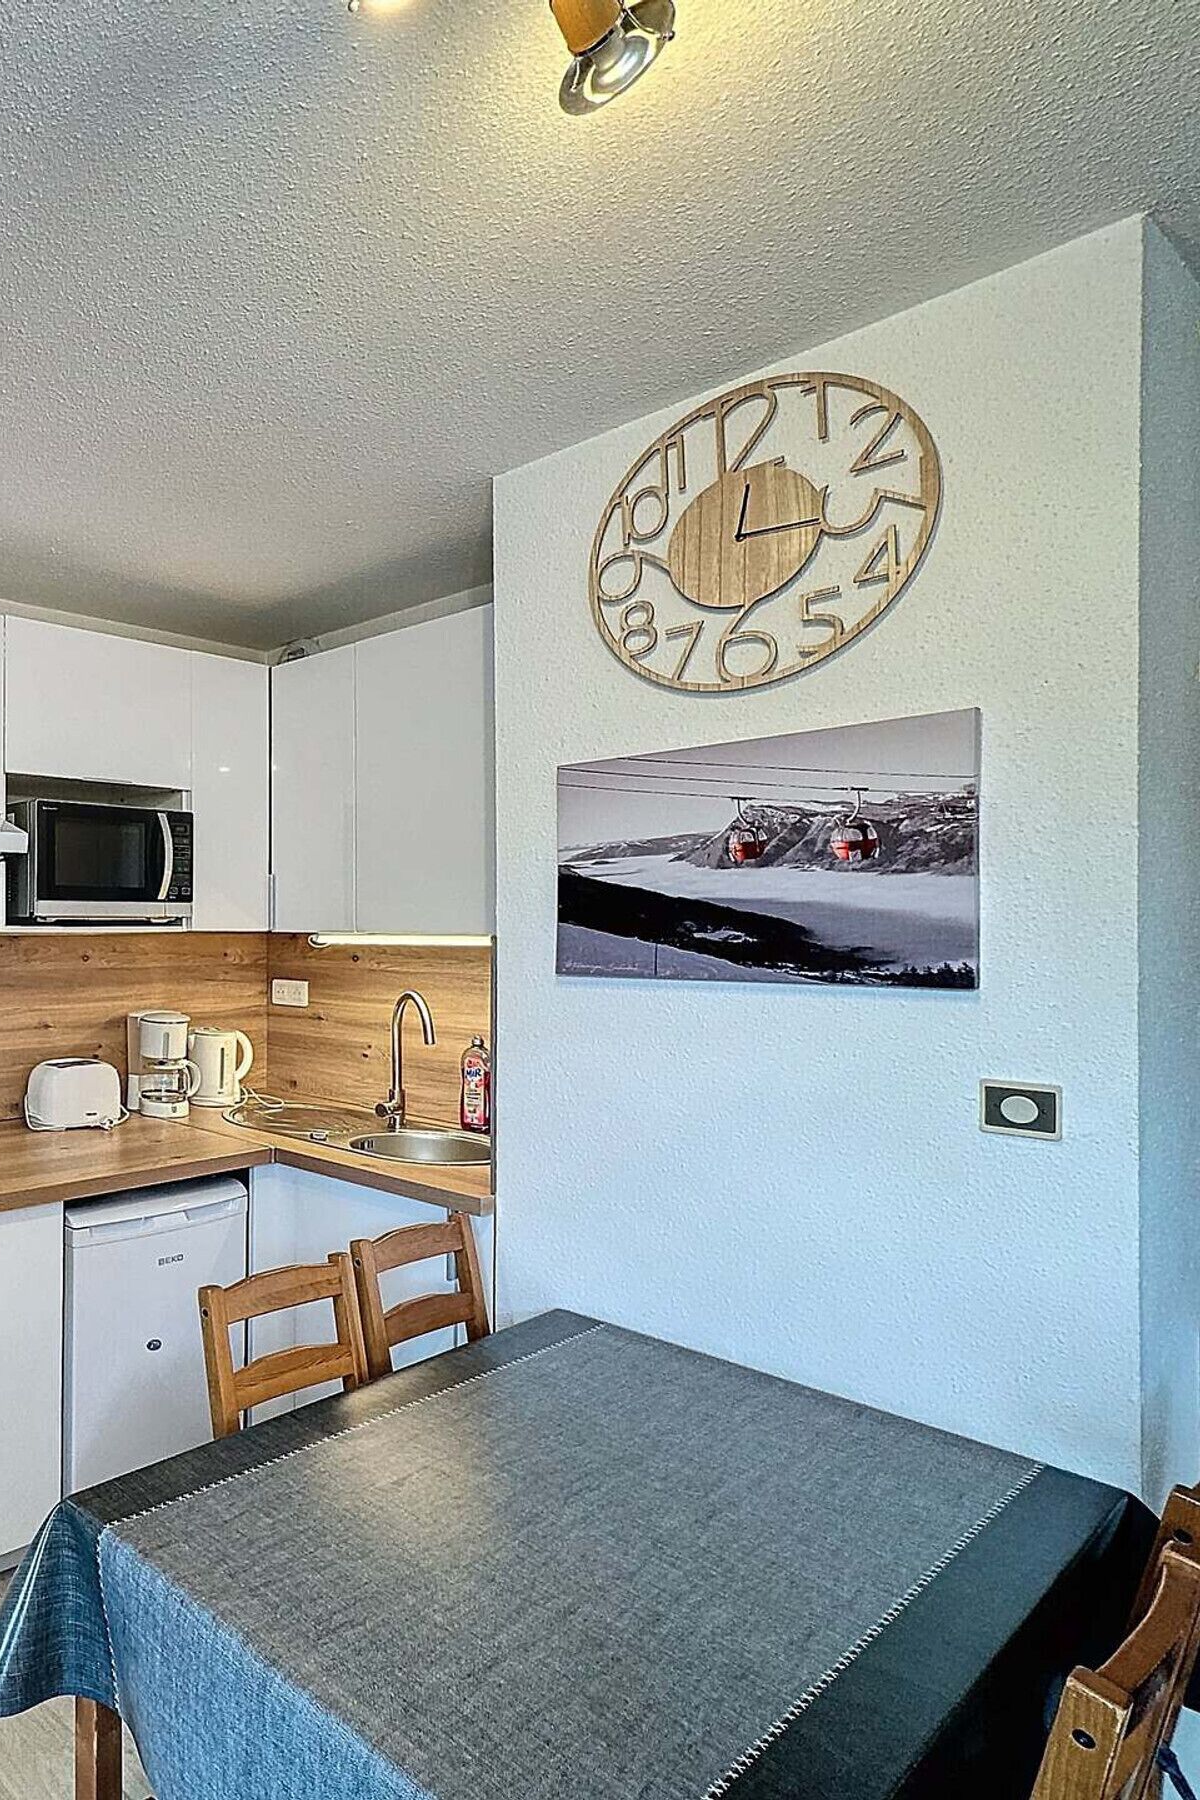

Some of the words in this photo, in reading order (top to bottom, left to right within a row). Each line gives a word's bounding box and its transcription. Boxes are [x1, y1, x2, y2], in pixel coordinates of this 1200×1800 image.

[699, 383, 785, 480] 12
[800, 381, 828, 440] 1
[850, 398, 904, 473] 2
[612, 486, 668, 546] 10
[819, 454, 930, 535] 3
[599, 549, 668, 602] 9
[853, 524, 908, 595] 4
[618, 601, 658, 658] 8
[665, 620, 705, 681] 7
[716, 600, 778, 684] 6
[796, 585, 845, 656] 5
[158, 1253, 184, 1267] BEKO
